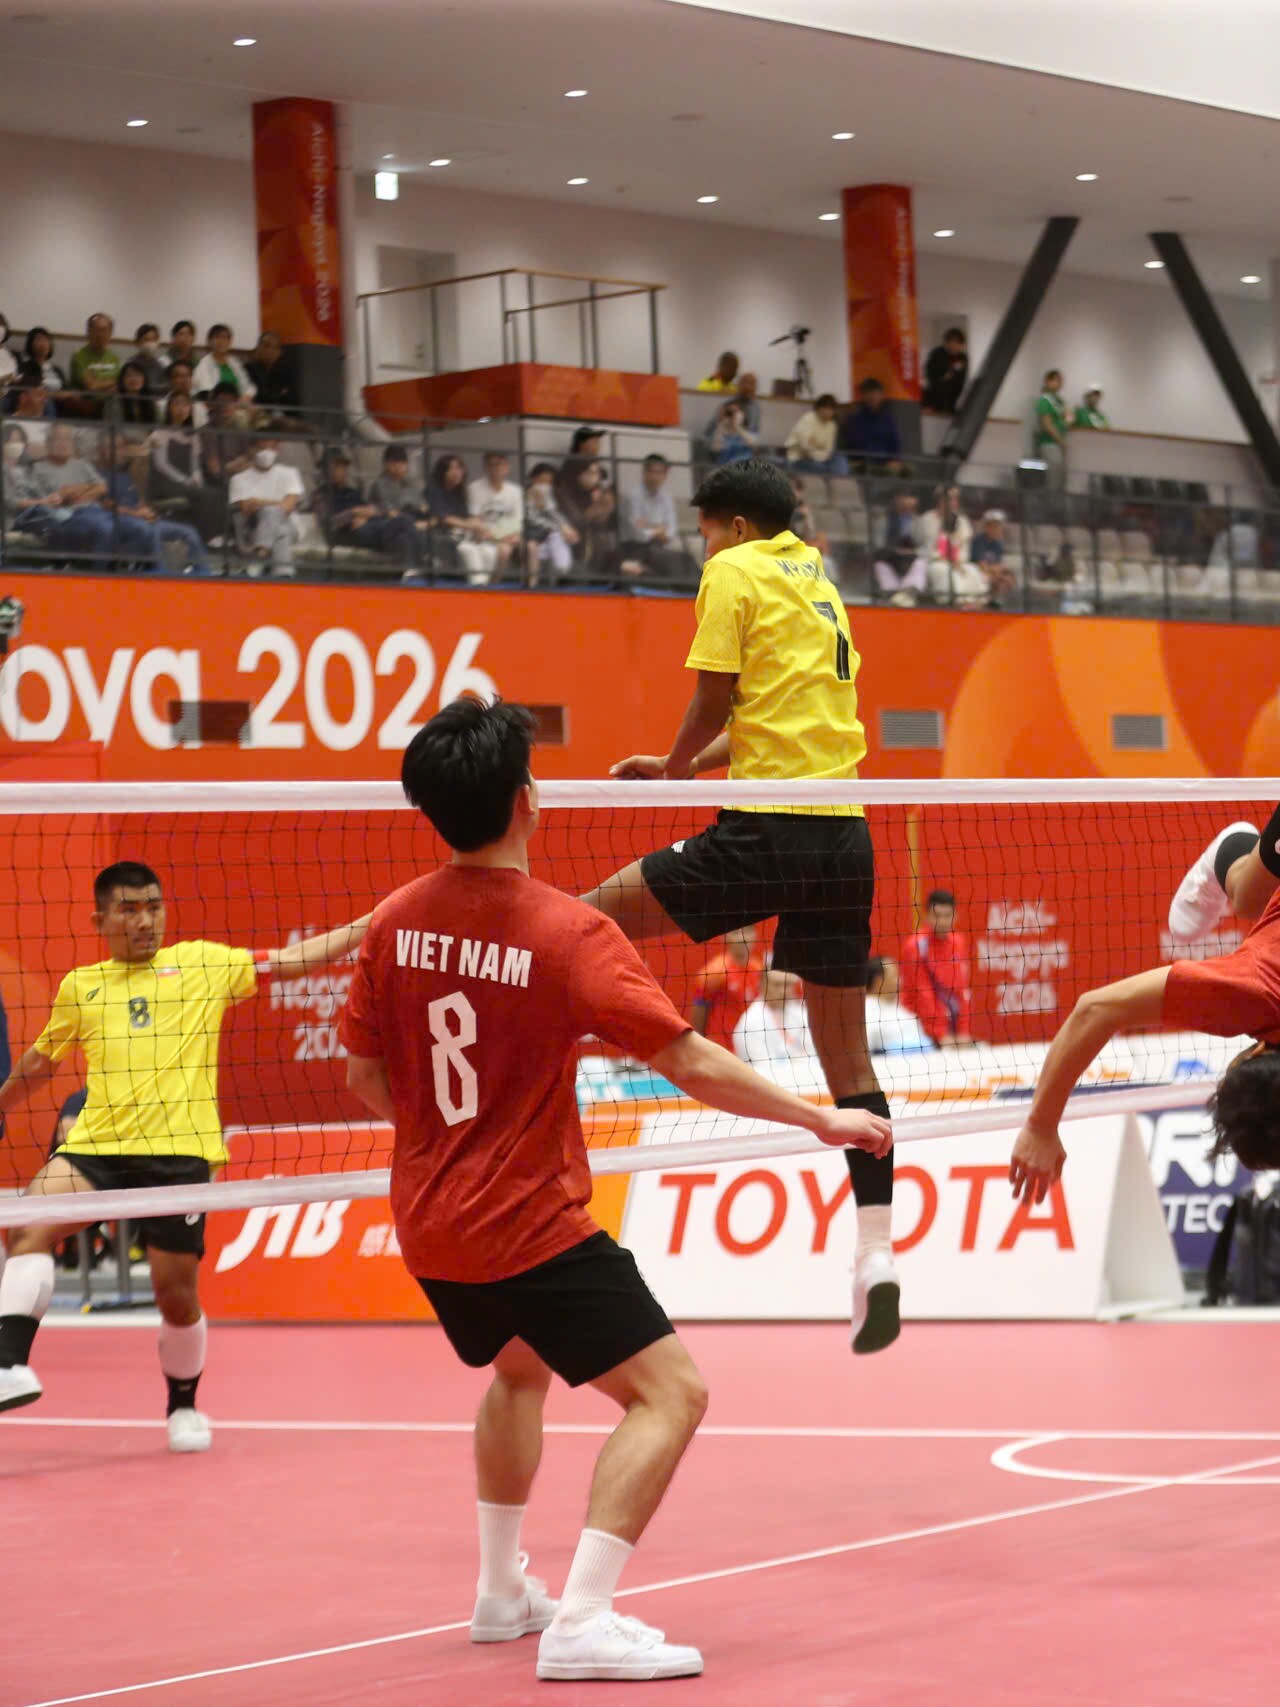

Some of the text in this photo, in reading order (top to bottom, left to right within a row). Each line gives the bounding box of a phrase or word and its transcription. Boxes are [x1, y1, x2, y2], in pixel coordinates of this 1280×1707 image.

[812, 601, 850, 680] 7
[237, 626, 499, 750] 2026
[396, 929, 454, 974] VIET
[458, 941, 532, 989] NAM
[128, 996, 152, 1029] 8
[427, 991, 478, 1127] 8
[658, 1167, 1076, 1257] TOYOTA
